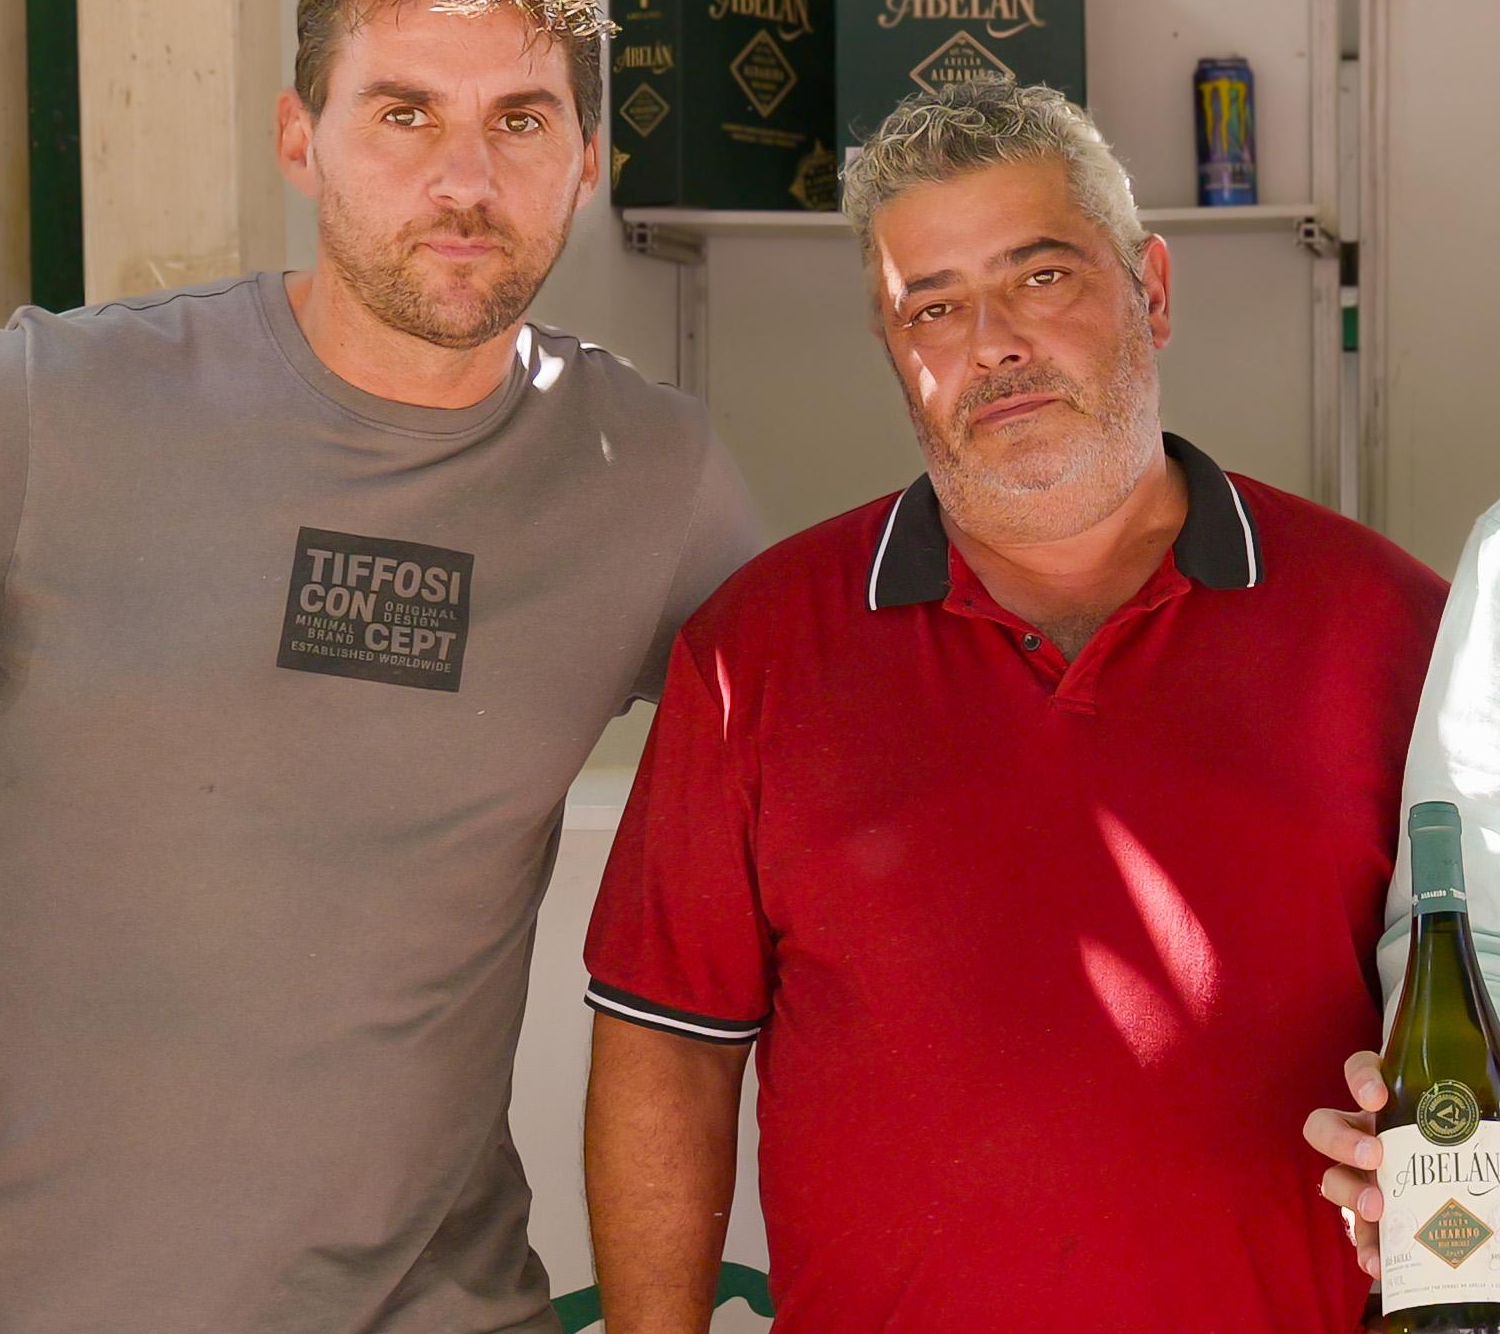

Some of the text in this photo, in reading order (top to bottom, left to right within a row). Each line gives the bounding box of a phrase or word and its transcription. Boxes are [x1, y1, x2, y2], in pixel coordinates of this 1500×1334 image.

[612, 40, 675, 75] ABELÁN
[306, 548, 461, 605] TIFFOSI
[299, 583, 378, 623] CON
[384, 600, 458, 621] ORIGINAL
[295, 614, 356, 635] MINIMAL
[383, 612, 441, 628] DESIGN
[307, 627, 355, 646] BRAND
[364, 622, 457, 662] CEPT
[291, 640, 452, 672] ESTABLISHED WORLDWIDE
